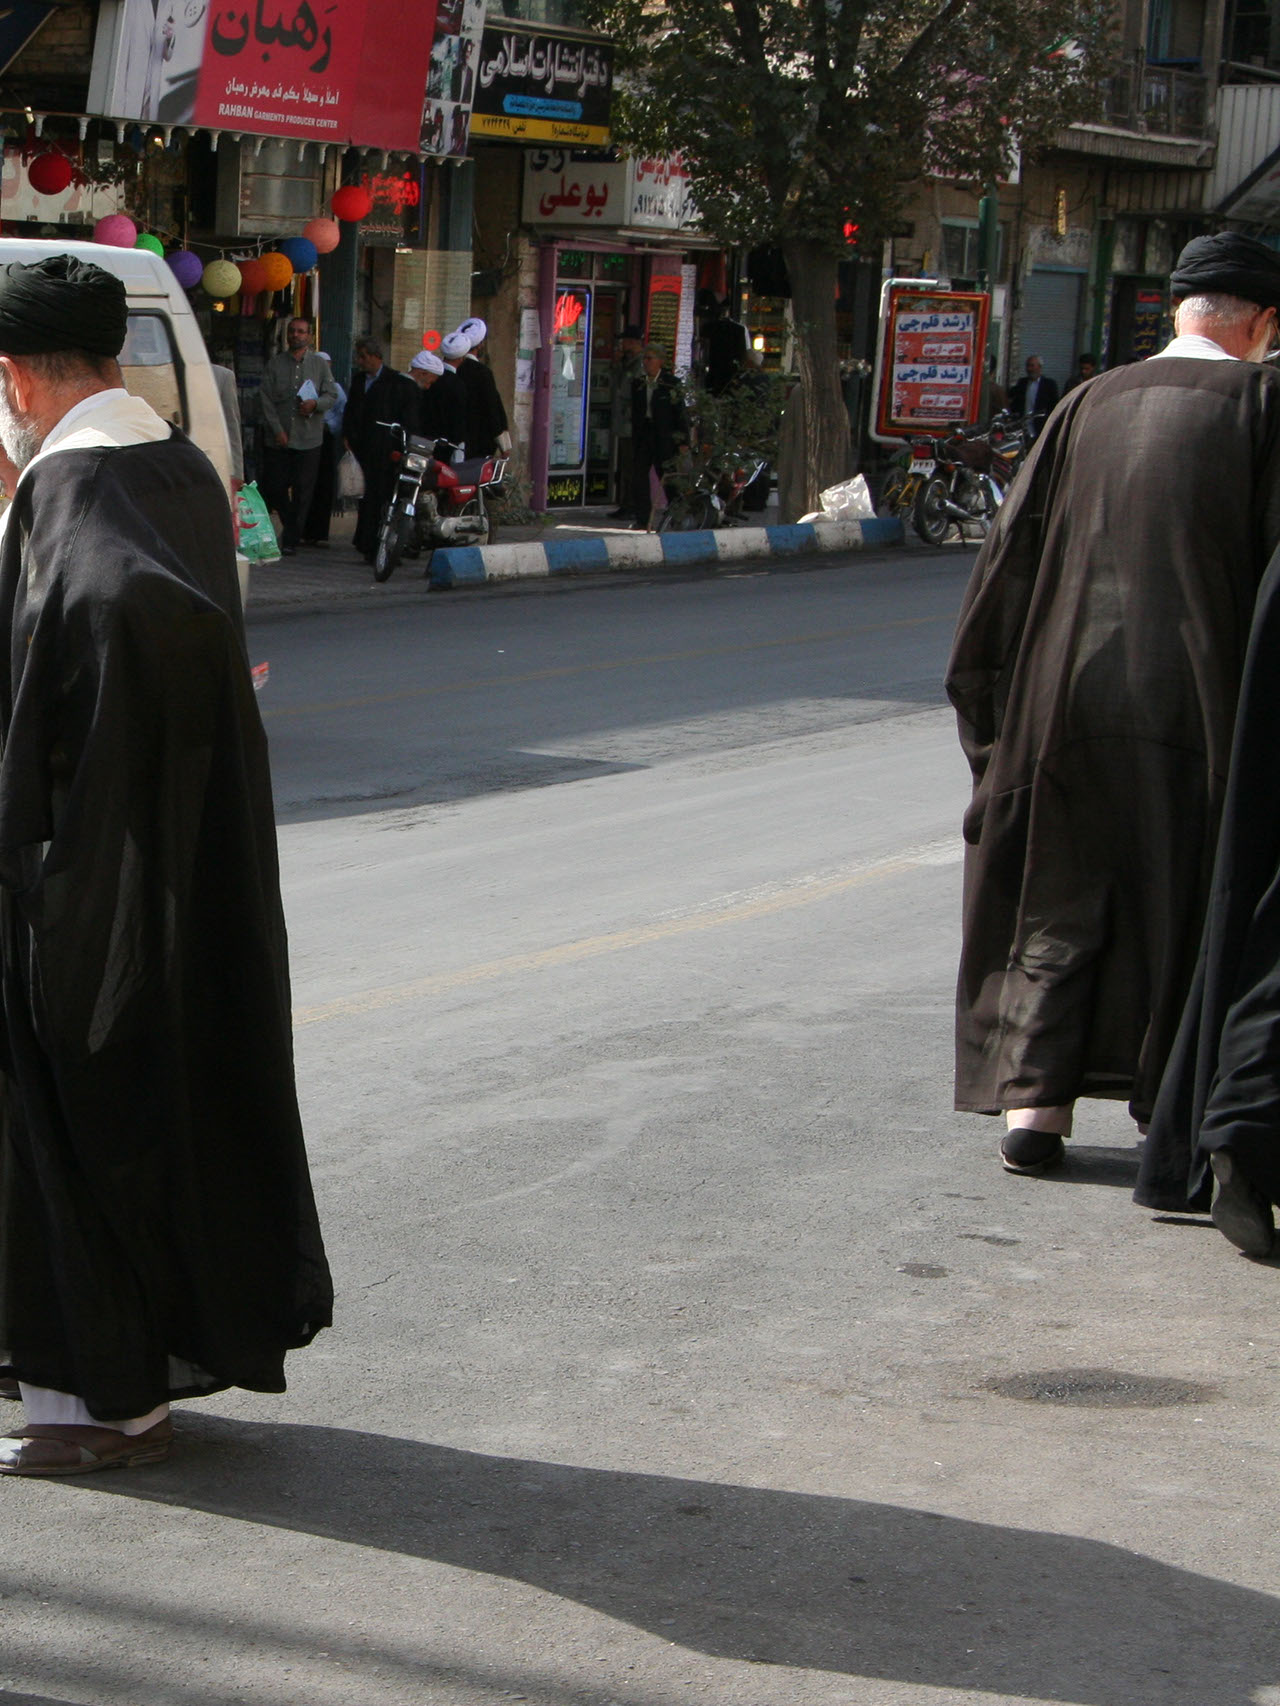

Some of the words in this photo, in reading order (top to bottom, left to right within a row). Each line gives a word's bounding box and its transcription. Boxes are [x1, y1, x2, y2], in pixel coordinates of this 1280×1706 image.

[479, 34, 535, 88] اسلامی
[531, 40, 586, 95] انتشارات
[577, 48, 608, 98] دفتر
[218, 103, 254, 118] RAHBAN
[254, 110, 285, 123] GARMENTS
[285, 115, 316, 126] PRODUCER
[316, 118, 338, 129] CENTER
[942, 315, 970, 330] ارشد
[940, 366, 968, 383] ارشد
